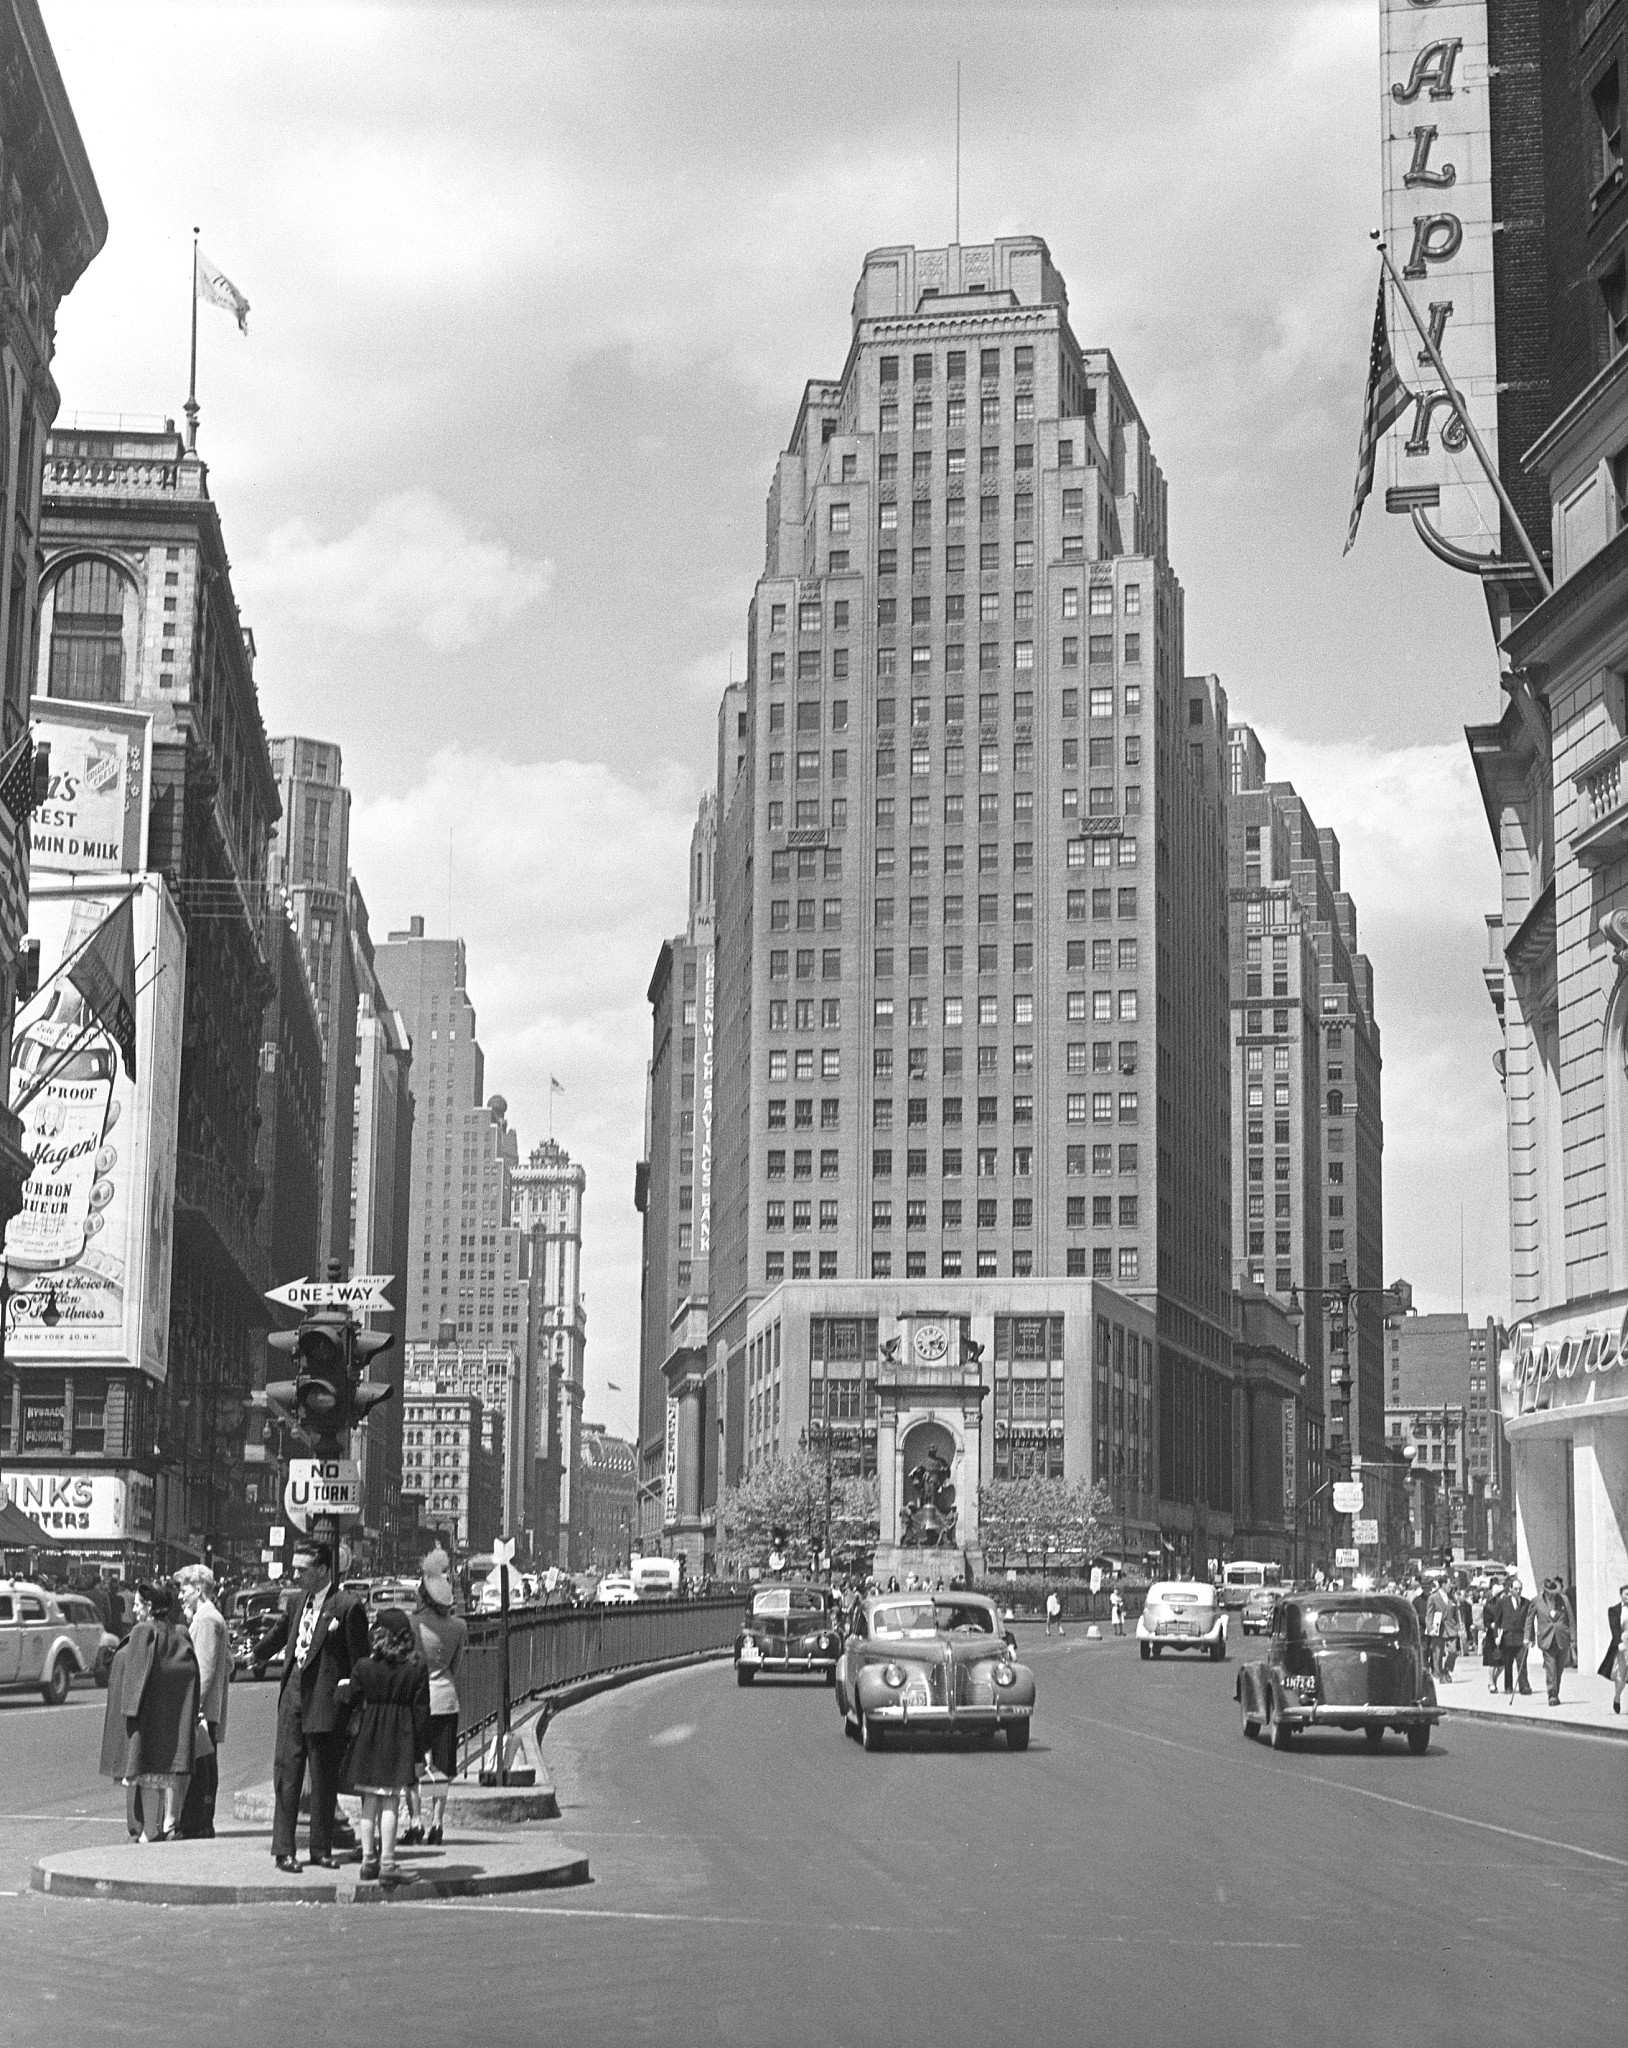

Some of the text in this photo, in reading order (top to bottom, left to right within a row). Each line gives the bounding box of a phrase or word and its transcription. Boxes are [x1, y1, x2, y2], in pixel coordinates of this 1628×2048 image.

[1391, 0, 1467, 456] ALPIN
[30, 834, 119, 860] MIN D MILK
[47, 1085, 97, 1100] PROOF
[30, 1132, 98, 1175] Hagen's
[700, 1193, 712, 1252] BANK
[35, 1275, 116, 1290] First Choice in
[311, 1463, 339, 1479] NO
[291, 1481, 349, 1505] U TURN
